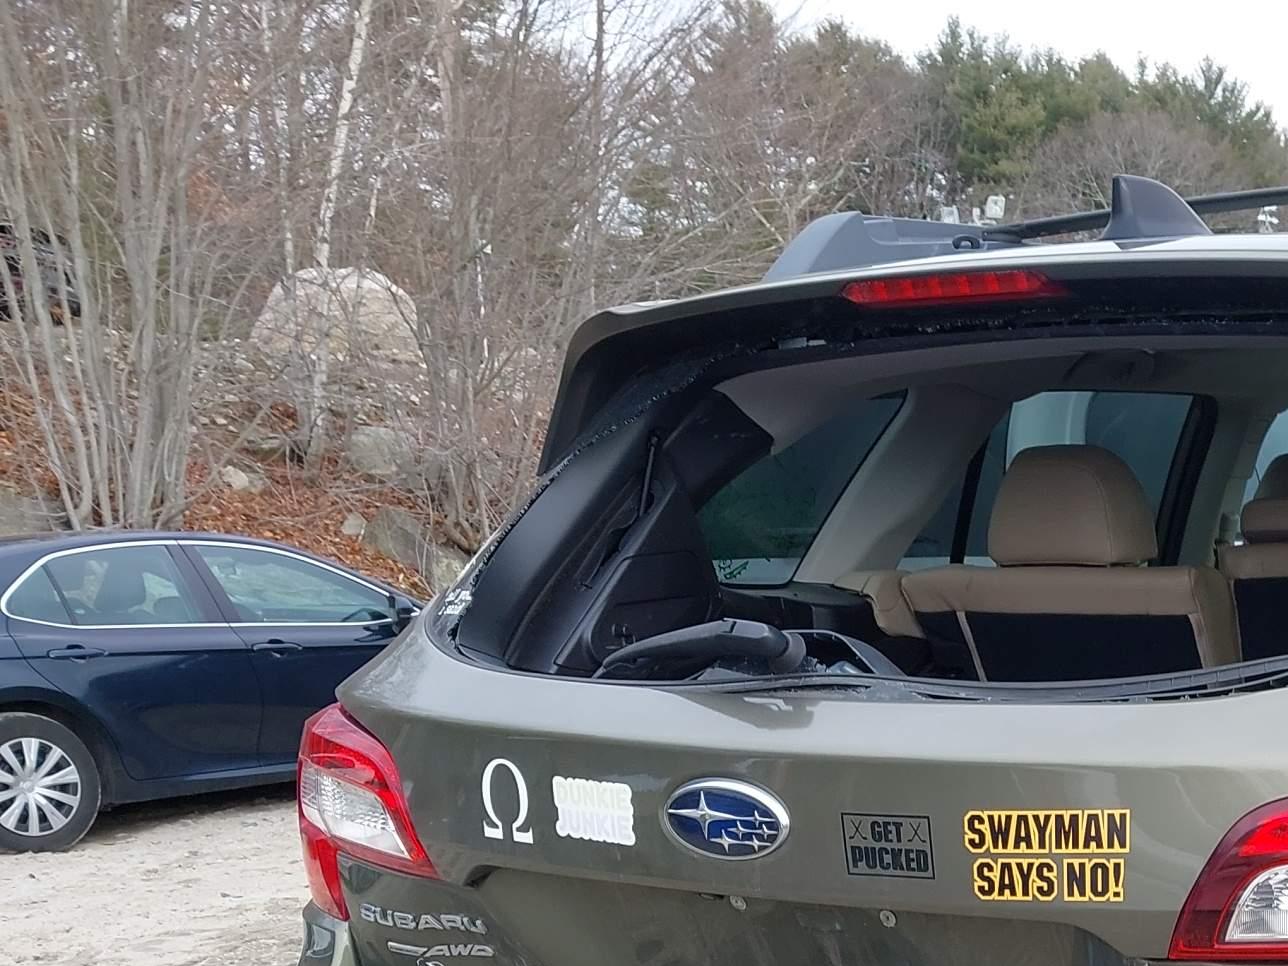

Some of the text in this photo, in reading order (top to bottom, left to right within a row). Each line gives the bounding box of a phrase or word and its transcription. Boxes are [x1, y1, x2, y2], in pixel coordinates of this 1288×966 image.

[555, 780, 631, 809] DUNKIE
[558, 807, 633, 841] JUNKIE
[870, 821, 903, 843] GET
[966, 811, 1129, 851] SWAYMAN
[850, 845, 930, 872] PUCKED
[975, 860, 1123, 899] SAYS NO!
[360, 903, 488, 935] SUBARU
[423, 944, 495, 957] AWD
